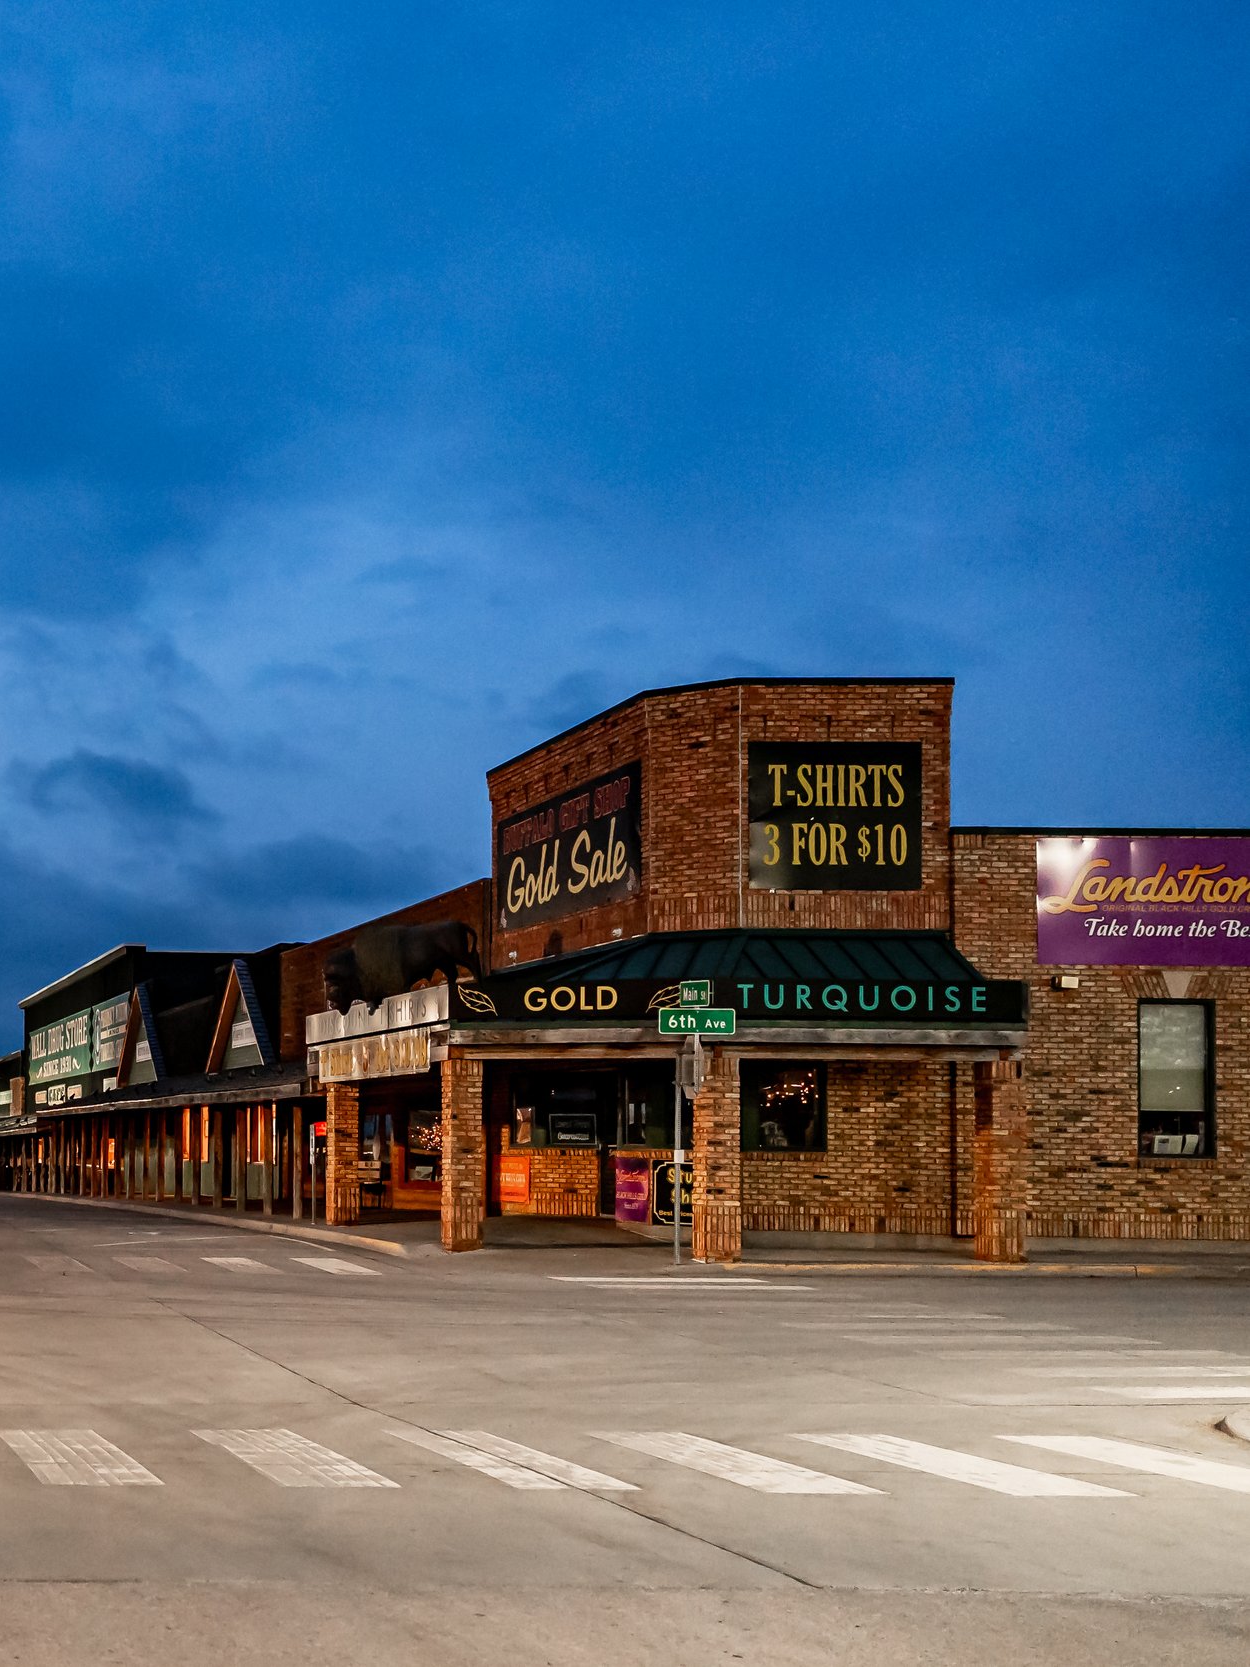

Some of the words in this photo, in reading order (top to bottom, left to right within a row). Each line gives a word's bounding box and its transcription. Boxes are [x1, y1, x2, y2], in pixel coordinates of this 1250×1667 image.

[768, 763, 905, 807] T-SHIRTS
[503, 808, 556, 856] BUFFALO
[559, 792, 590, 833] GIFT
[593, 775, 631, 820] SHOP
[763, 823, 781, 866] 3
[791, 822, 849, 866] FOR
[857, 823, 908, 866] $10
[507, 838, 560, 914] Gold
[567, 816, 628, 894] Sale
[1102, 904, 1145, 913] ORIGINAL
[1149, 904, 1179, 913] BLACK
[1182, 904, 1208, 913] HILLS
[1210, 904, 1236, 913] GOLD
[1084, 916, 1128, 937] Take
[1132, 919, 1184, 937] home
[1188, 919, 1217, 937] the
[1219, 919, 1250, 938] Be
[524, 986, 618, 1012] GOLD
[682, 987, 699, 1001] Main
[737, 984, 987, 1012] TURQUOISE
[388, 994, 428, 1023] SHIRTS
[668, 1014, 696, 1029] 6th
[705, 1019, 727, 1029] Ave
[30, 1031, 47, 1060] WALL
[65, 1014, 88, 1050] STORE
[43, 1058, 59, 1078] SINCE
